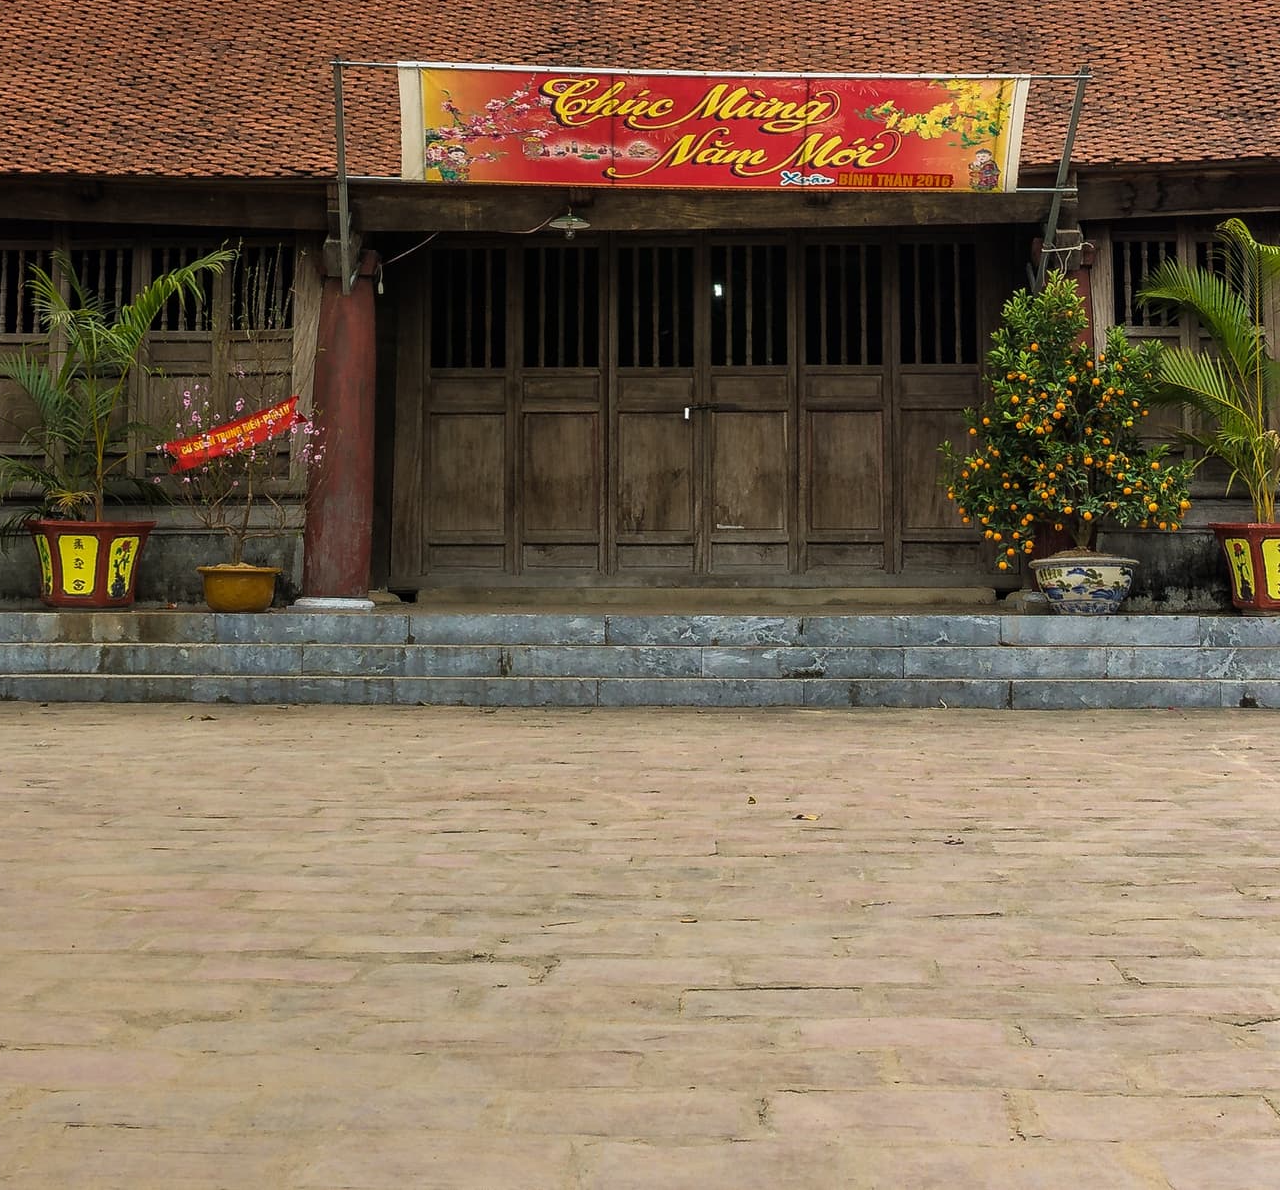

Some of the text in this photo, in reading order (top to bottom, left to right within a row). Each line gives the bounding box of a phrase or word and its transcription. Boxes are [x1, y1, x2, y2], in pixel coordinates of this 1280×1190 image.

[540, 78, 841, 133] Chúc Mừng
[604, 127, 903, 179] Năm Mới
[780, 170, 951, 187] Xuân BÍNH THÂN 2016
